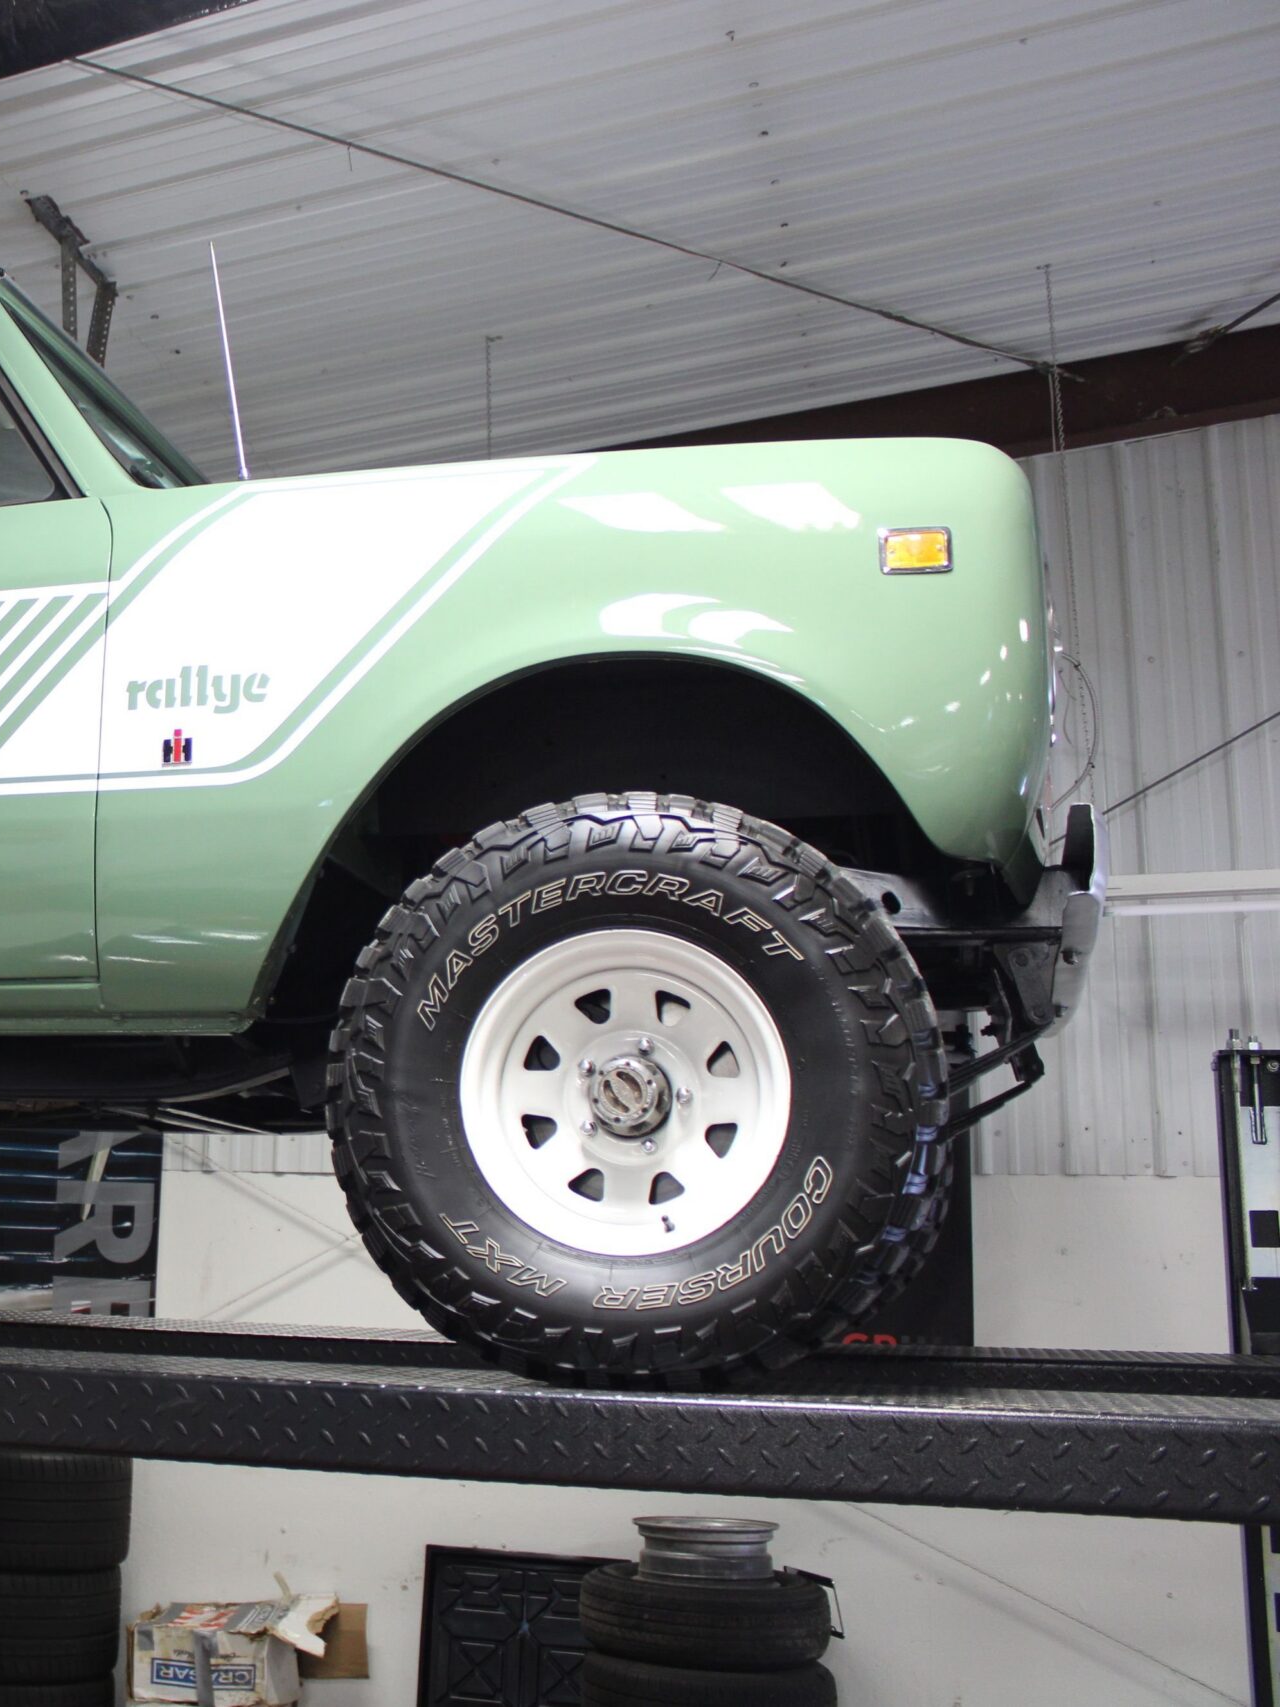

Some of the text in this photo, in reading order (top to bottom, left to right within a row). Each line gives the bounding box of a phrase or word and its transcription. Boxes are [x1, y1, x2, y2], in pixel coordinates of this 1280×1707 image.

[126, 665, 270, 714] rallye
[416, 869, 804, 1031] MASTERCRAFT
[440, 1155, 833, 1311] COURSER MXT
